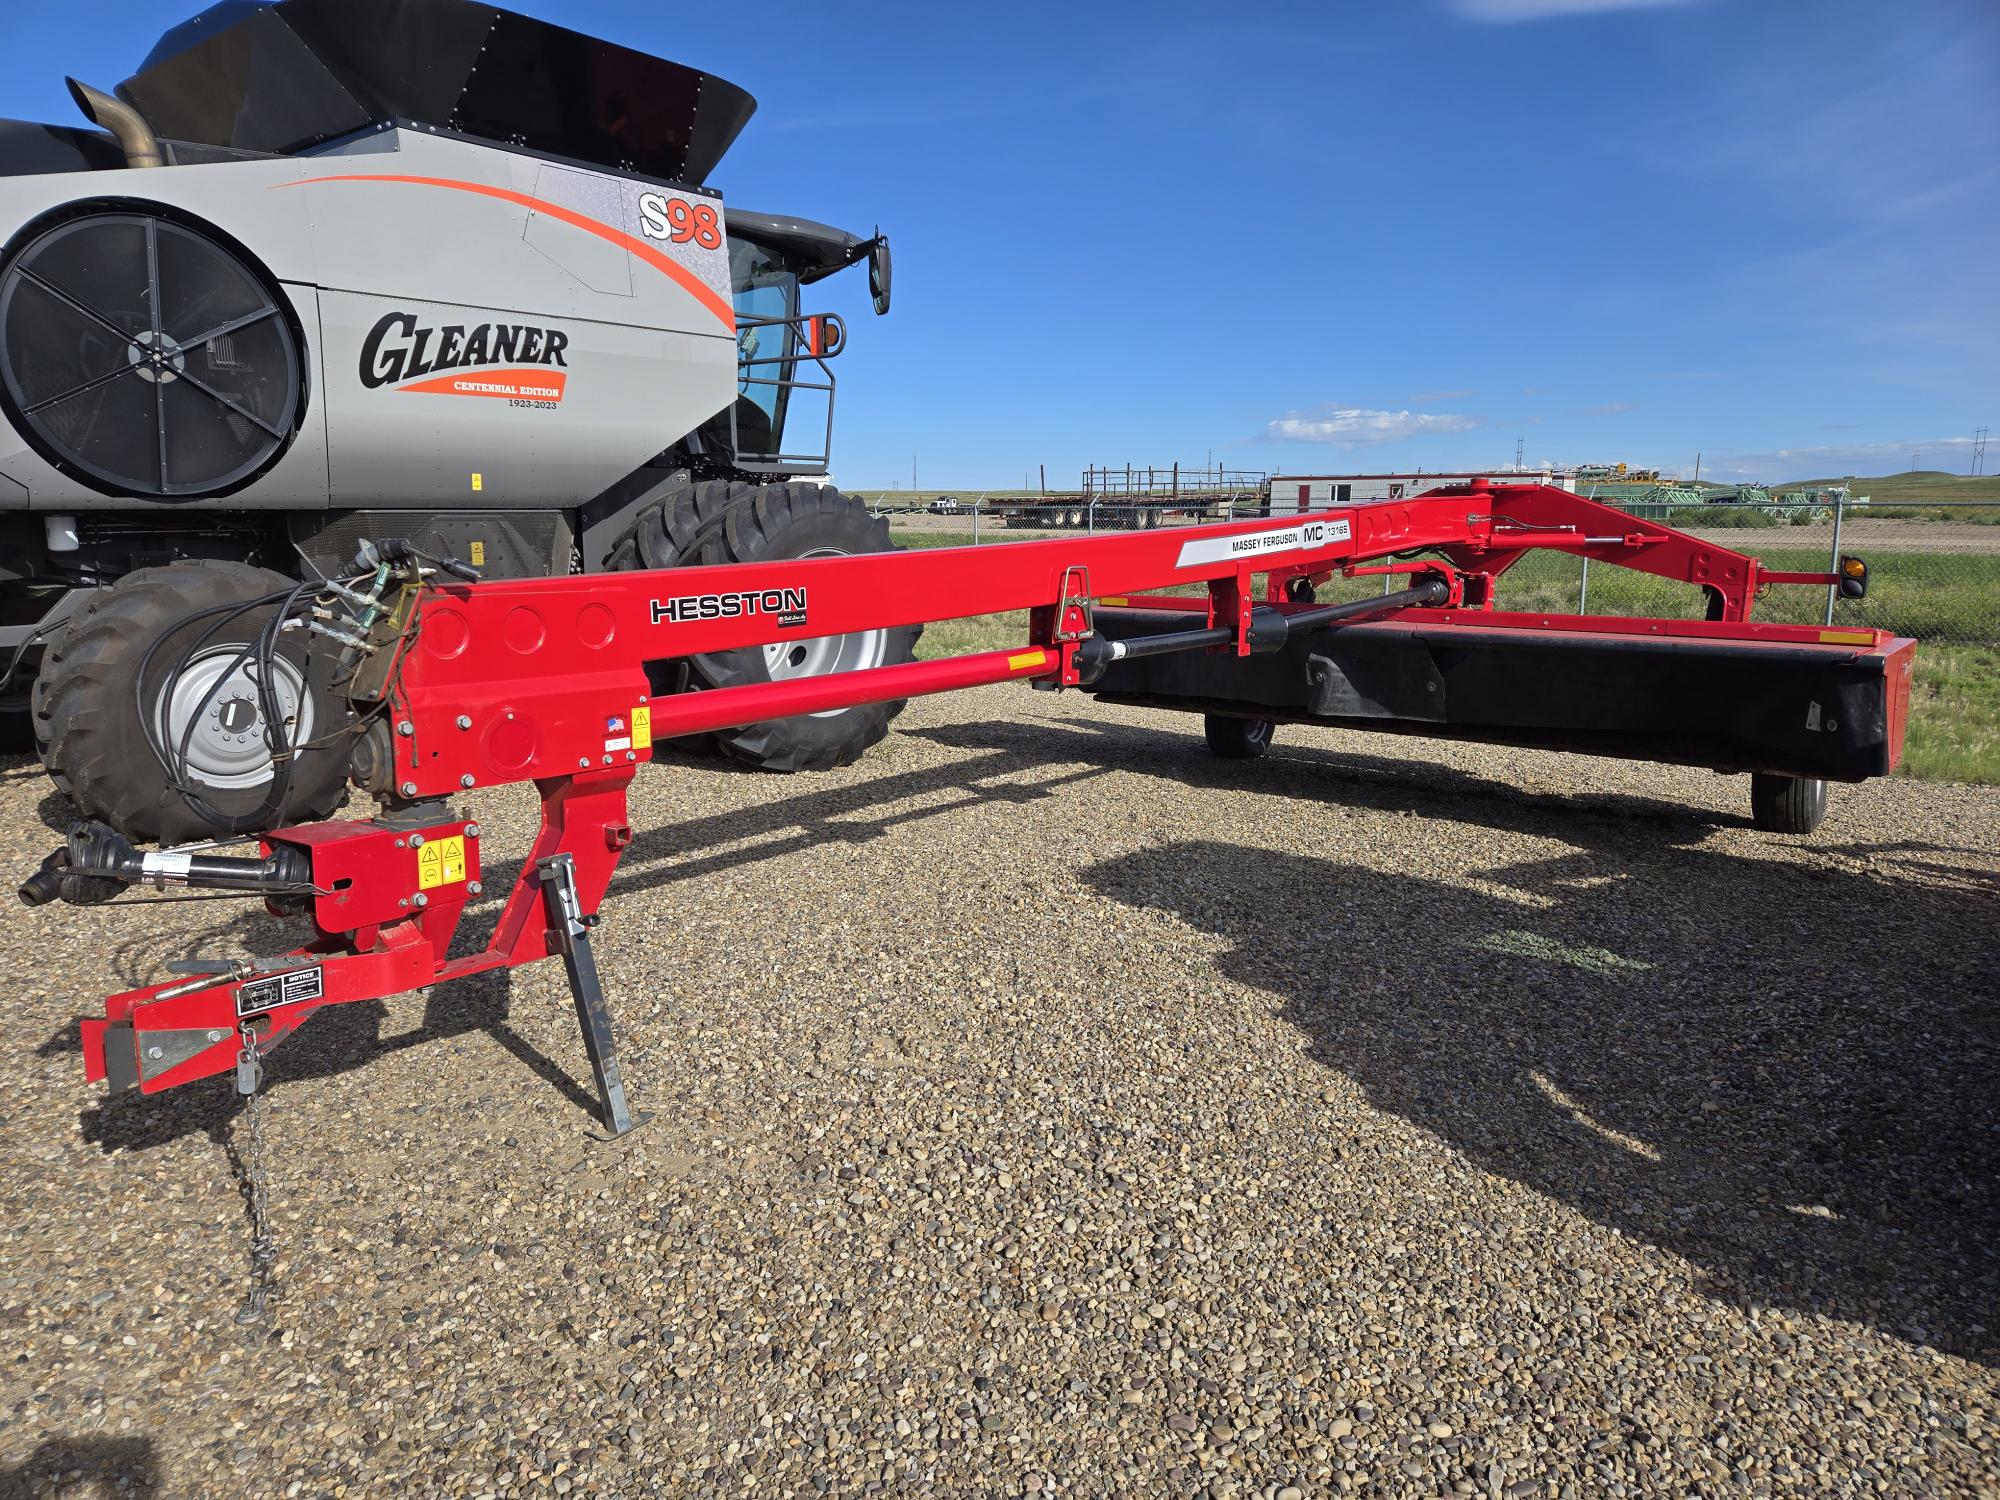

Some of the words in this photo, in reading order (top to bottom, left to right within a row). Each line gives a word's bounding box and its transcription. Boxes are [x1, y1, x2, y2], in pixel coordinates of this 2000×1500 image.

[639, 192, 721, 250] S98
[359, 311, 568, 389] GLEANER
[454, 381, 517, 394] CENTENNIAL
[520, 386, 559, 397] EDITION
[508, 399, 557, 410] 1923-2023
[1232, 538, 1261, 552] MASSEY
[1263, 533, 1298, 547] FERGUSON
[1304, 525, 1324, 543] MC
[650, 587, 806, 624] HESSTON
[289, 972, 315, 982] NOTICE
